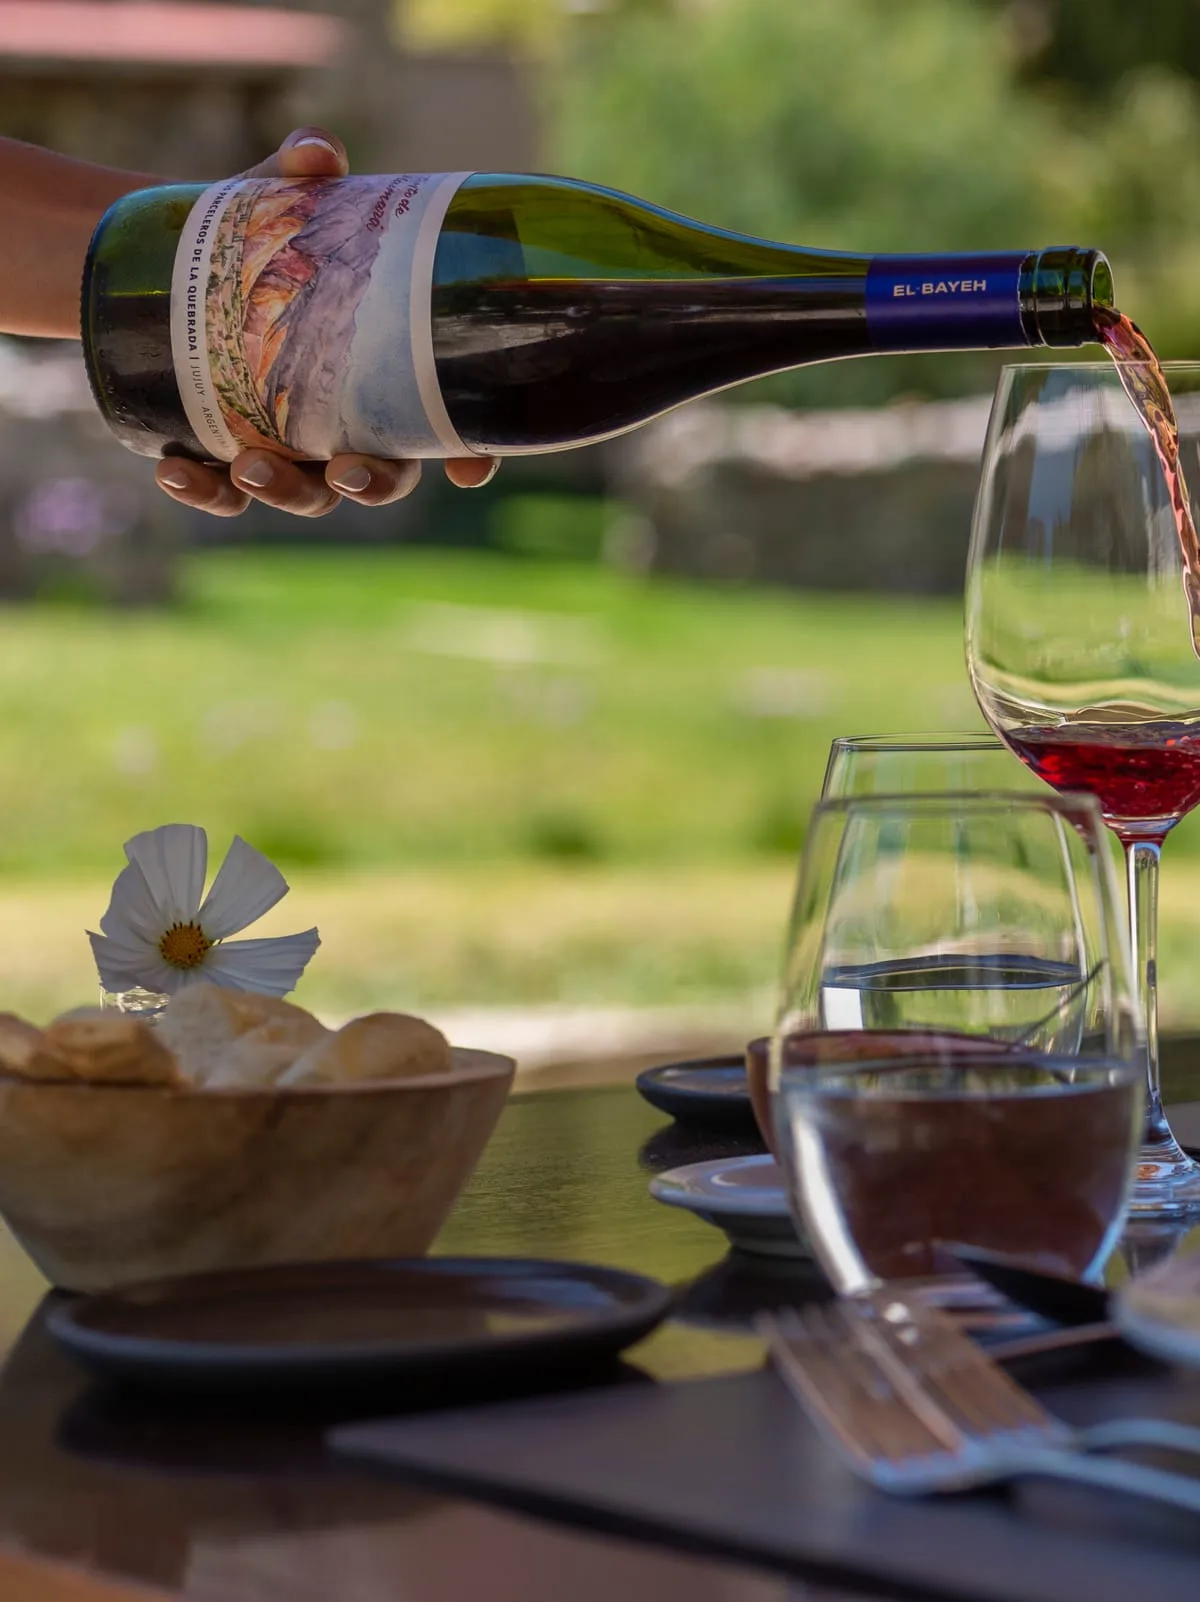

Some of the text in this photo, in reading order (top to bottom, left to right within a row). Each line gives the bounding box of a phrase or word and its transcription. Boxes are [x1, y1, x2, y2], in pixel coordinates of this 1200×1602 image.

[196, 192, 227, 245] PARCELEROS
[395, 199, 409, 219] de
[192, 249, 202, 262] DE
[189, 267, 199, 281] LA
[893, 279, 987, 297] EL BAYEH
[187, 286, 198, 352] QUEBRADA
[190, 365, 205, 396] JUJUY
